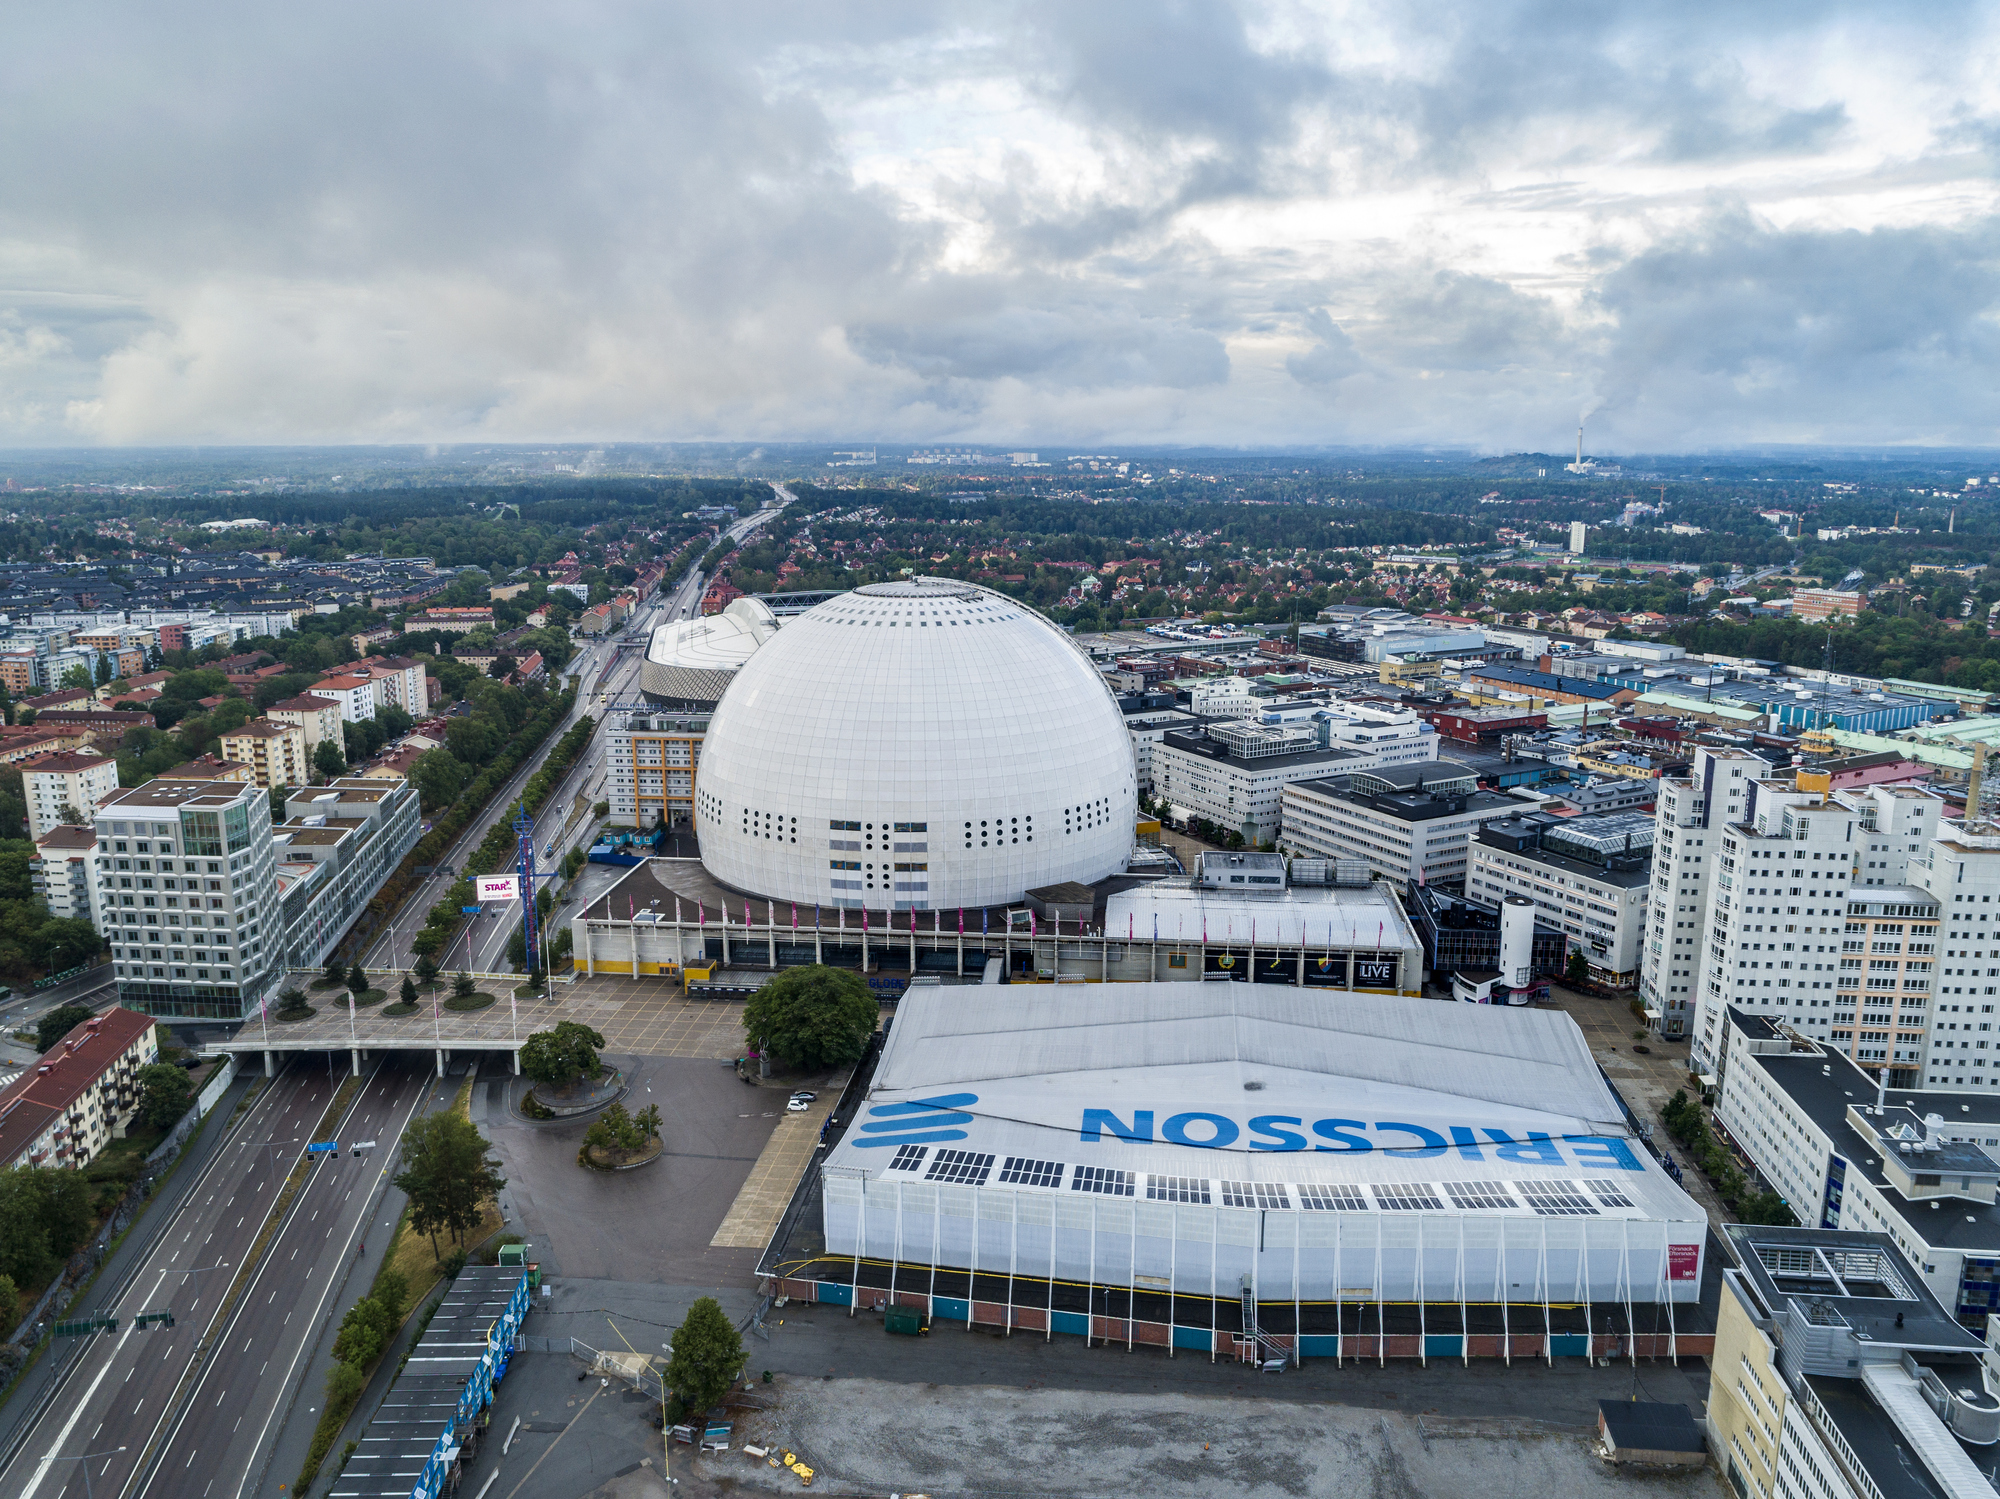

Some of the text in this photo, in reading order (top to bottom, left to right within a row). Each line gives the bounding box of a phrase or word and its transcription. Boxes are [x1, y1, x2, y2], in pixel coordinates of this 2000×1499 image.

[485, 883, 507, 891] STAR
[1361, 965, 1390, 978] LIVE
[868, 978, 906, 989] GLOBE
[1080, 1108, 1646, 1172] ERICSSON
